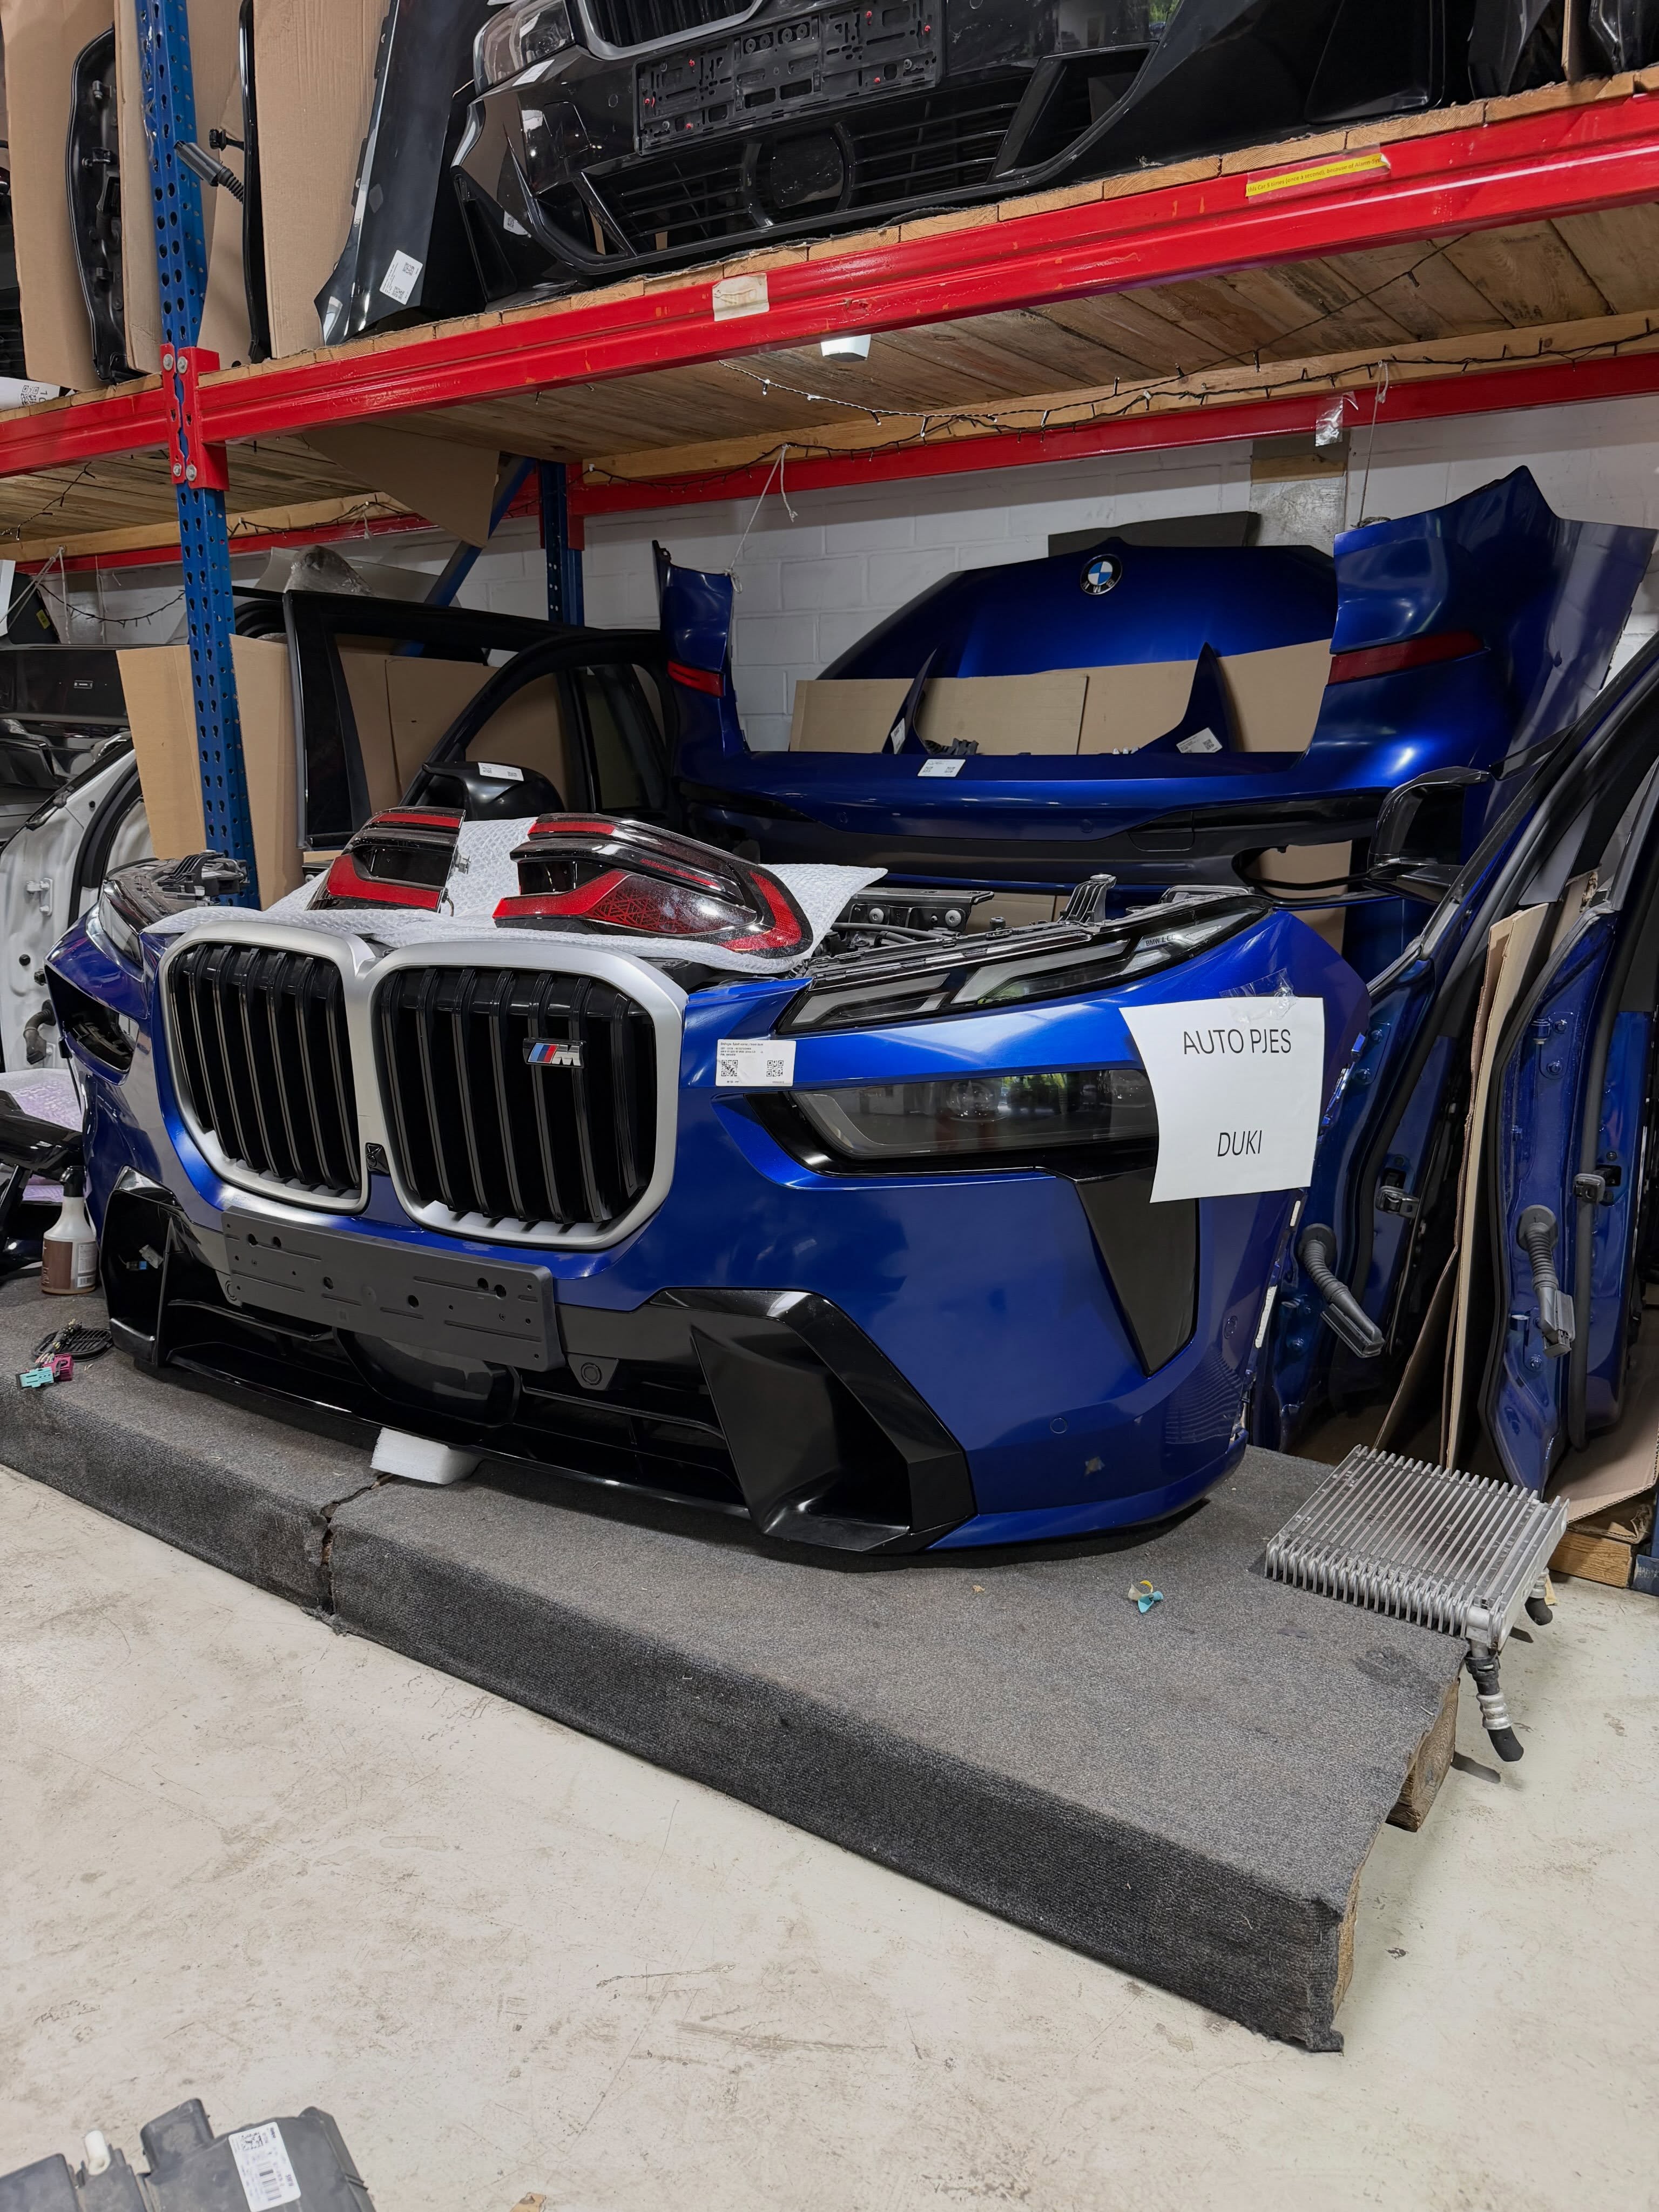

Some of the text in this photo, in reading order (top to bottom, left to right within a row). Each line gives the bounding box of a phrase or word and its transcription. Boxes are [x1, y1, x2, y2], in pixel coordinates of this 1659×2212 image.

[1326, 165, 1347, 173] because
[1145, 938, 1160, 947] BMW
[1183, 1028, 1292, 1055] AUTO PJES
[551, 1044, 581, 1067] M
[1217, 1130, 1263, 1158] DUKI
